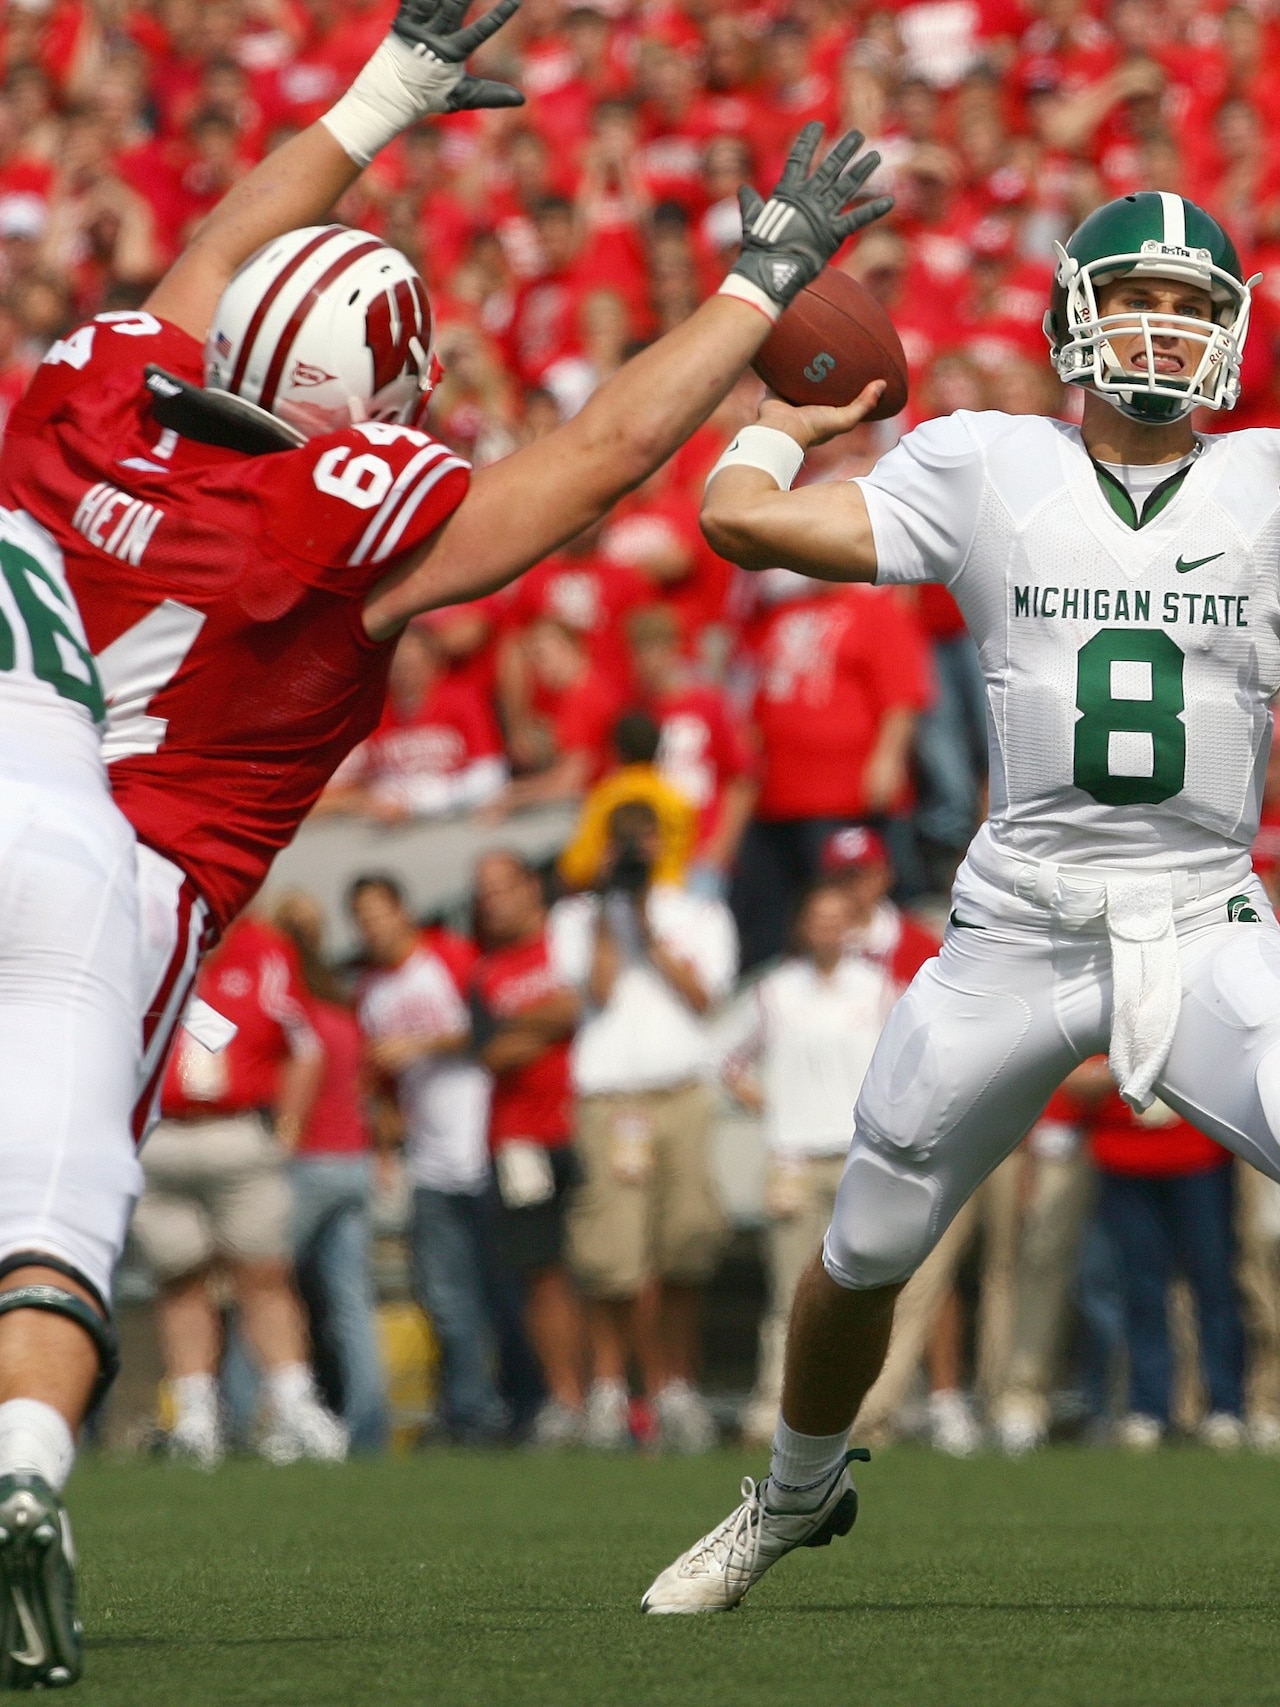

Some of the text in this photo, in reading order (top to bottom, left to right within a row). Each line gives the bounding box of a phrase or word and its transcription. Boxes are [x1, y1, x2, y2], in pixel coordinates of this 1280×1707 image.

[803, 351, 837, 383] S
[312, 420, 433, 510] 64
[71, 480, 165, 568] HEIN
[1014, 585, 1250, 627] MICHIGAN STATE
[1073, 627, 1187, 805] 8
